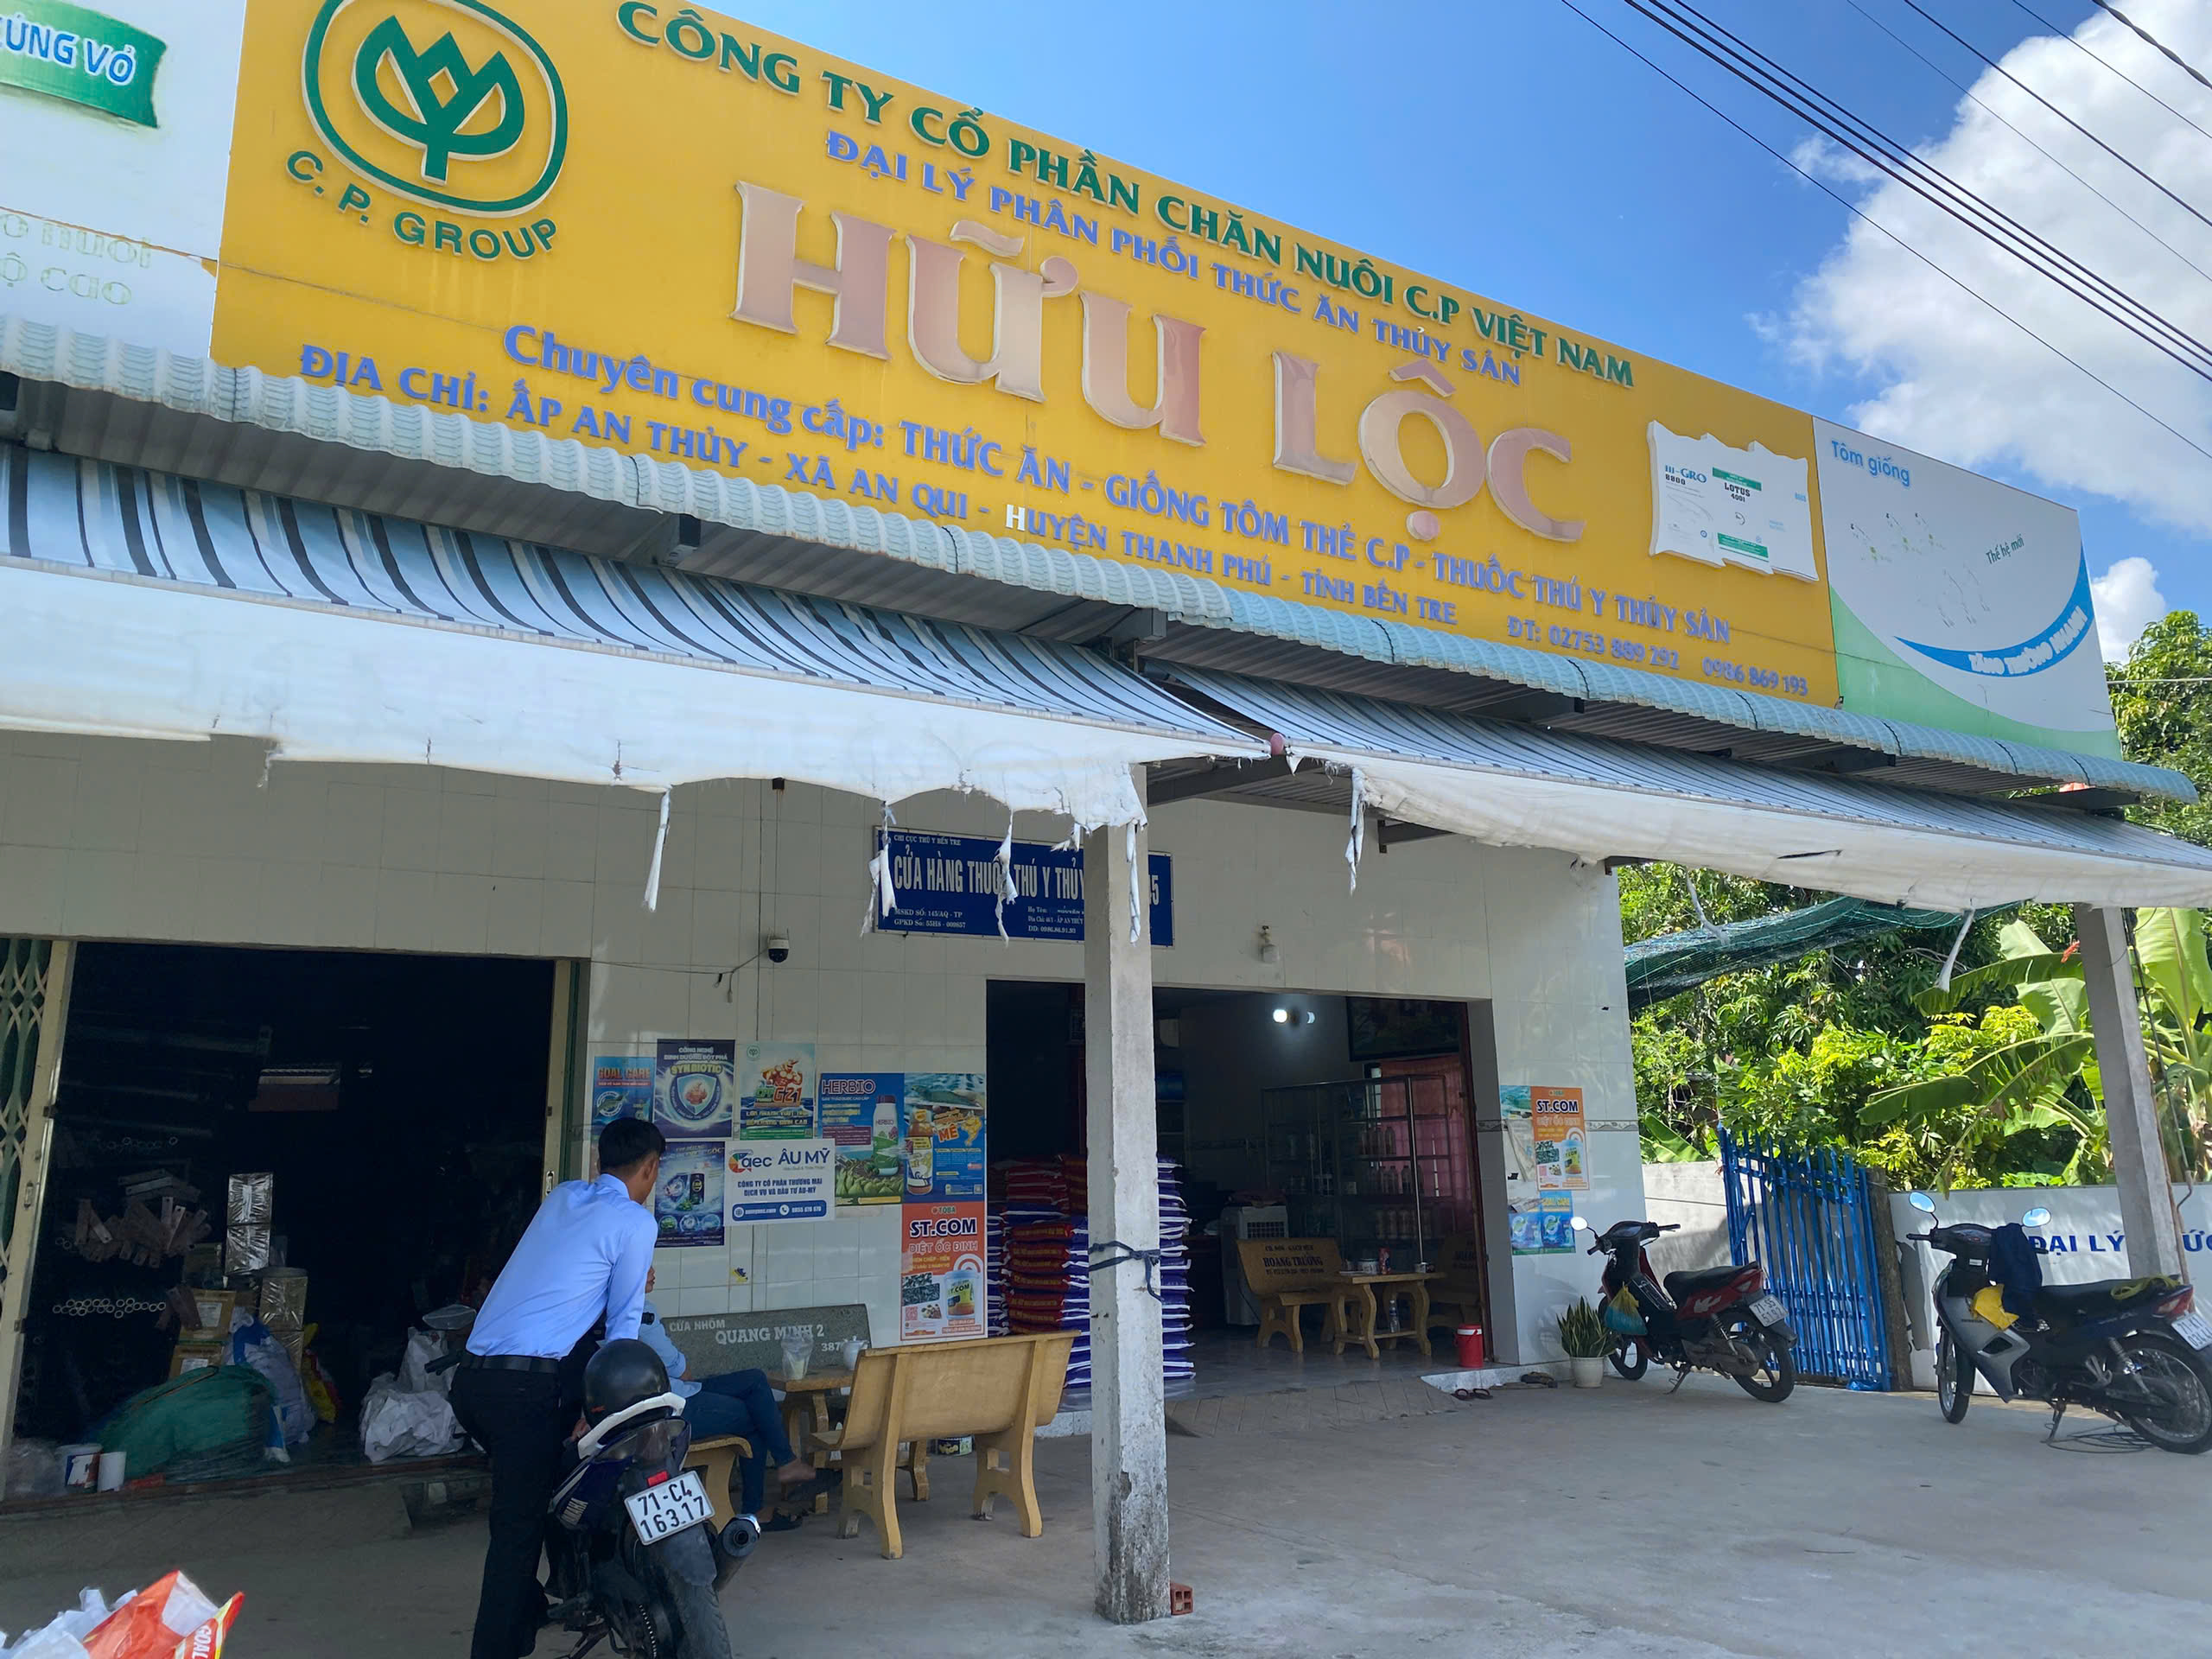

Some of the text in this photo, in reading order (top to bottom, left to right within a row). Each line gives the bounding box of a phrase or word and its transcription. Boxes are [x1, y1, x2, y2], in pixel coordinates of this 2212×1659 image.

[0, 12, 134, 84] ỨNG VỎ
[616, 1, 1636, 389] CÔNG TY CỔ PHẦN CHĂN NUÔI C.P VIỆT NAM
[392, 211, 559, 262] GROUP
[823, 130, 1522, 387] ĐẠI LÝ PHÂN PHỐI THỨC ĂN THỦY SẢN
[728, 180, 1586, 543] HỮU LỘC
[1831, 439, 1911, 488] Tôm giống
[299, 343, 385, 391] ĐỊA
[397, 365, 490, 413] CHỈ:
[505, 377, 563, 428] ẤP
[570, 404, 632, 445] AN
[645, 419, 749, 468] THỦY
[785, 451, 837, 491] XÃ
[849, 467, 899, 505] AN
[911, 481, 968, 520] QUI
[1004, 503, 1108, 551] HUYỆN
[1222, 553, 1272, 586] PHÚ
[1362, 575, 1408, 615] BẾN
[1415, 595, 1459, 625] TRE
[503, 324, 680, 401] Chuyên
[690, 378, 793, 435] cung
[800, 397, 885, 452] cấp:
[899, 420, 1004, 477] THỨC
[1016, 443, 1071, 494] ĂN
[1104, 469, 1211, 528] GIỐNG
[1219, 499, 1291, 546] TÔM
[1299, 518, 1358, 562] THẺ
[1365, 537, 1412, 572] C.P
[1432, 552, 1526, 600] THUỐC
[1530, 574, 1583, 613] THÚ
[1590, 588, 1607, 617] Y
[1613, 594, 1679, 632] THỦY
[1683, 607, 1731, 644] SẢN
[1723, 481, 1751, 498] LOTUS
[1730, 493, 1746, 503] 4001
[1985, 533, 2024, 565] Thế hệ mới
[1507, 614, 1542, 643] ĐT:
[1548, 624, 1605, 655] 02753
[1701, 655, 1745, 683] 0986
[1783, 674, 1809, 696] 193
[893, 843, 924, 891] CỬA
[926, 849, 964, 893] HÀNG
[1013, 857, 1038, 898] THÚ
[1042, 867, 1051, 899] Y
[822, 1078, 877, 1095] HERBIO
[1535, 1099, 1580, 1115] ST.COM
[778, 1147, 802, 1165] ÂU
[804, 1147, 831, 1164] MỸ
[910, 1217, 977, 1237] ST.COM
[2028, 1235, 2078, 1255] ĐẠI
[2088, 1230, 2126, 1252] LÝ
[693, 1319, 726, 1332] NHÔM
[715, 1326, 771, 1346] QUANG
[816, 1325, 825, 1338] 2
[638, 1479, 693, 1516] 71-C4
